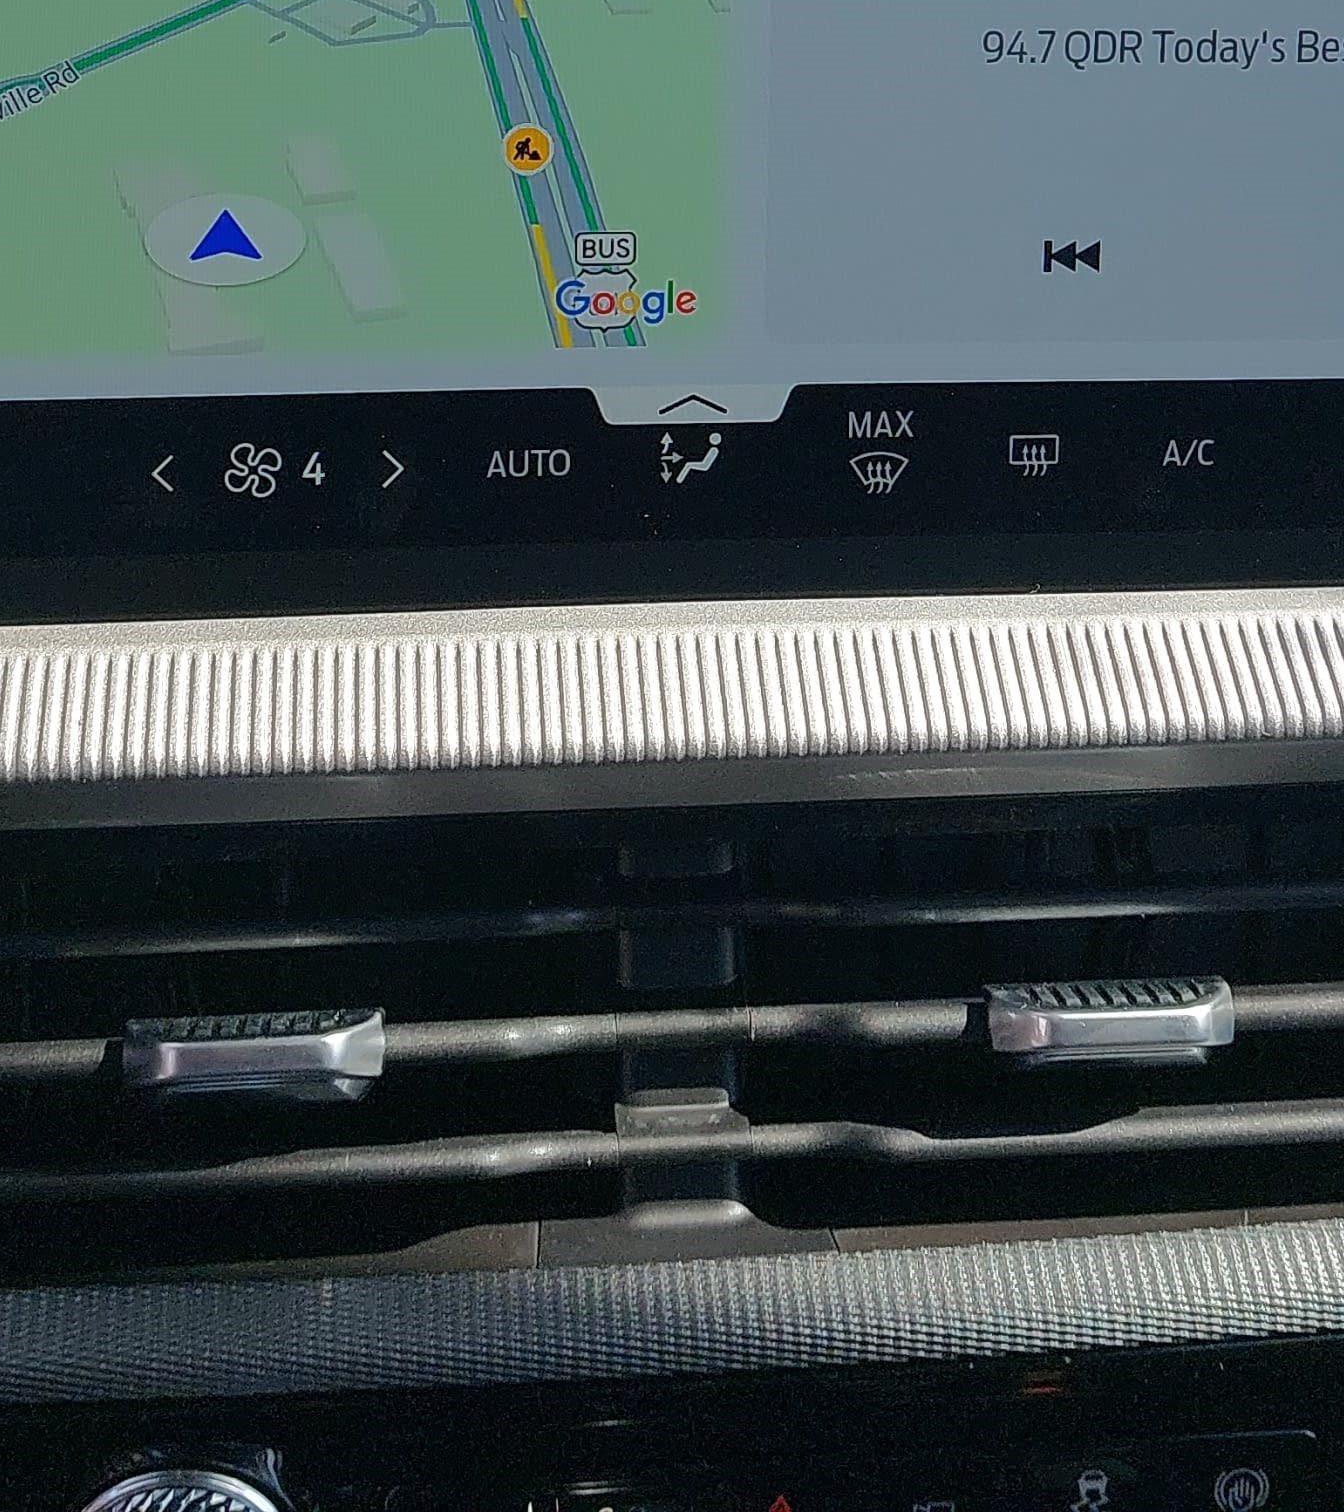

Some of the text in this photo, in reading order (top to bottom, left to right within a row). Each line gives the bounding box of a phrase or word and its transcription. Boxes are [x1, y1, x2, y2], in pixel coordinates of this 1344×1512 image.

[982, 29, 1057, 65] 94.7
[1064, 29, 1144, 70] QDR
[1152, 29, 1287, 71] Today's
[43, 60, 80, 94] Rd
[582, 237, 631, 260] BUS
[556, 279, 697, 324] Google
[847, 410, 915, 440] MAX
[301, 451, 327, 486] 4
[486, 448, 572, 479] AUTO
[1162, 438, 1215, 467] A/C
